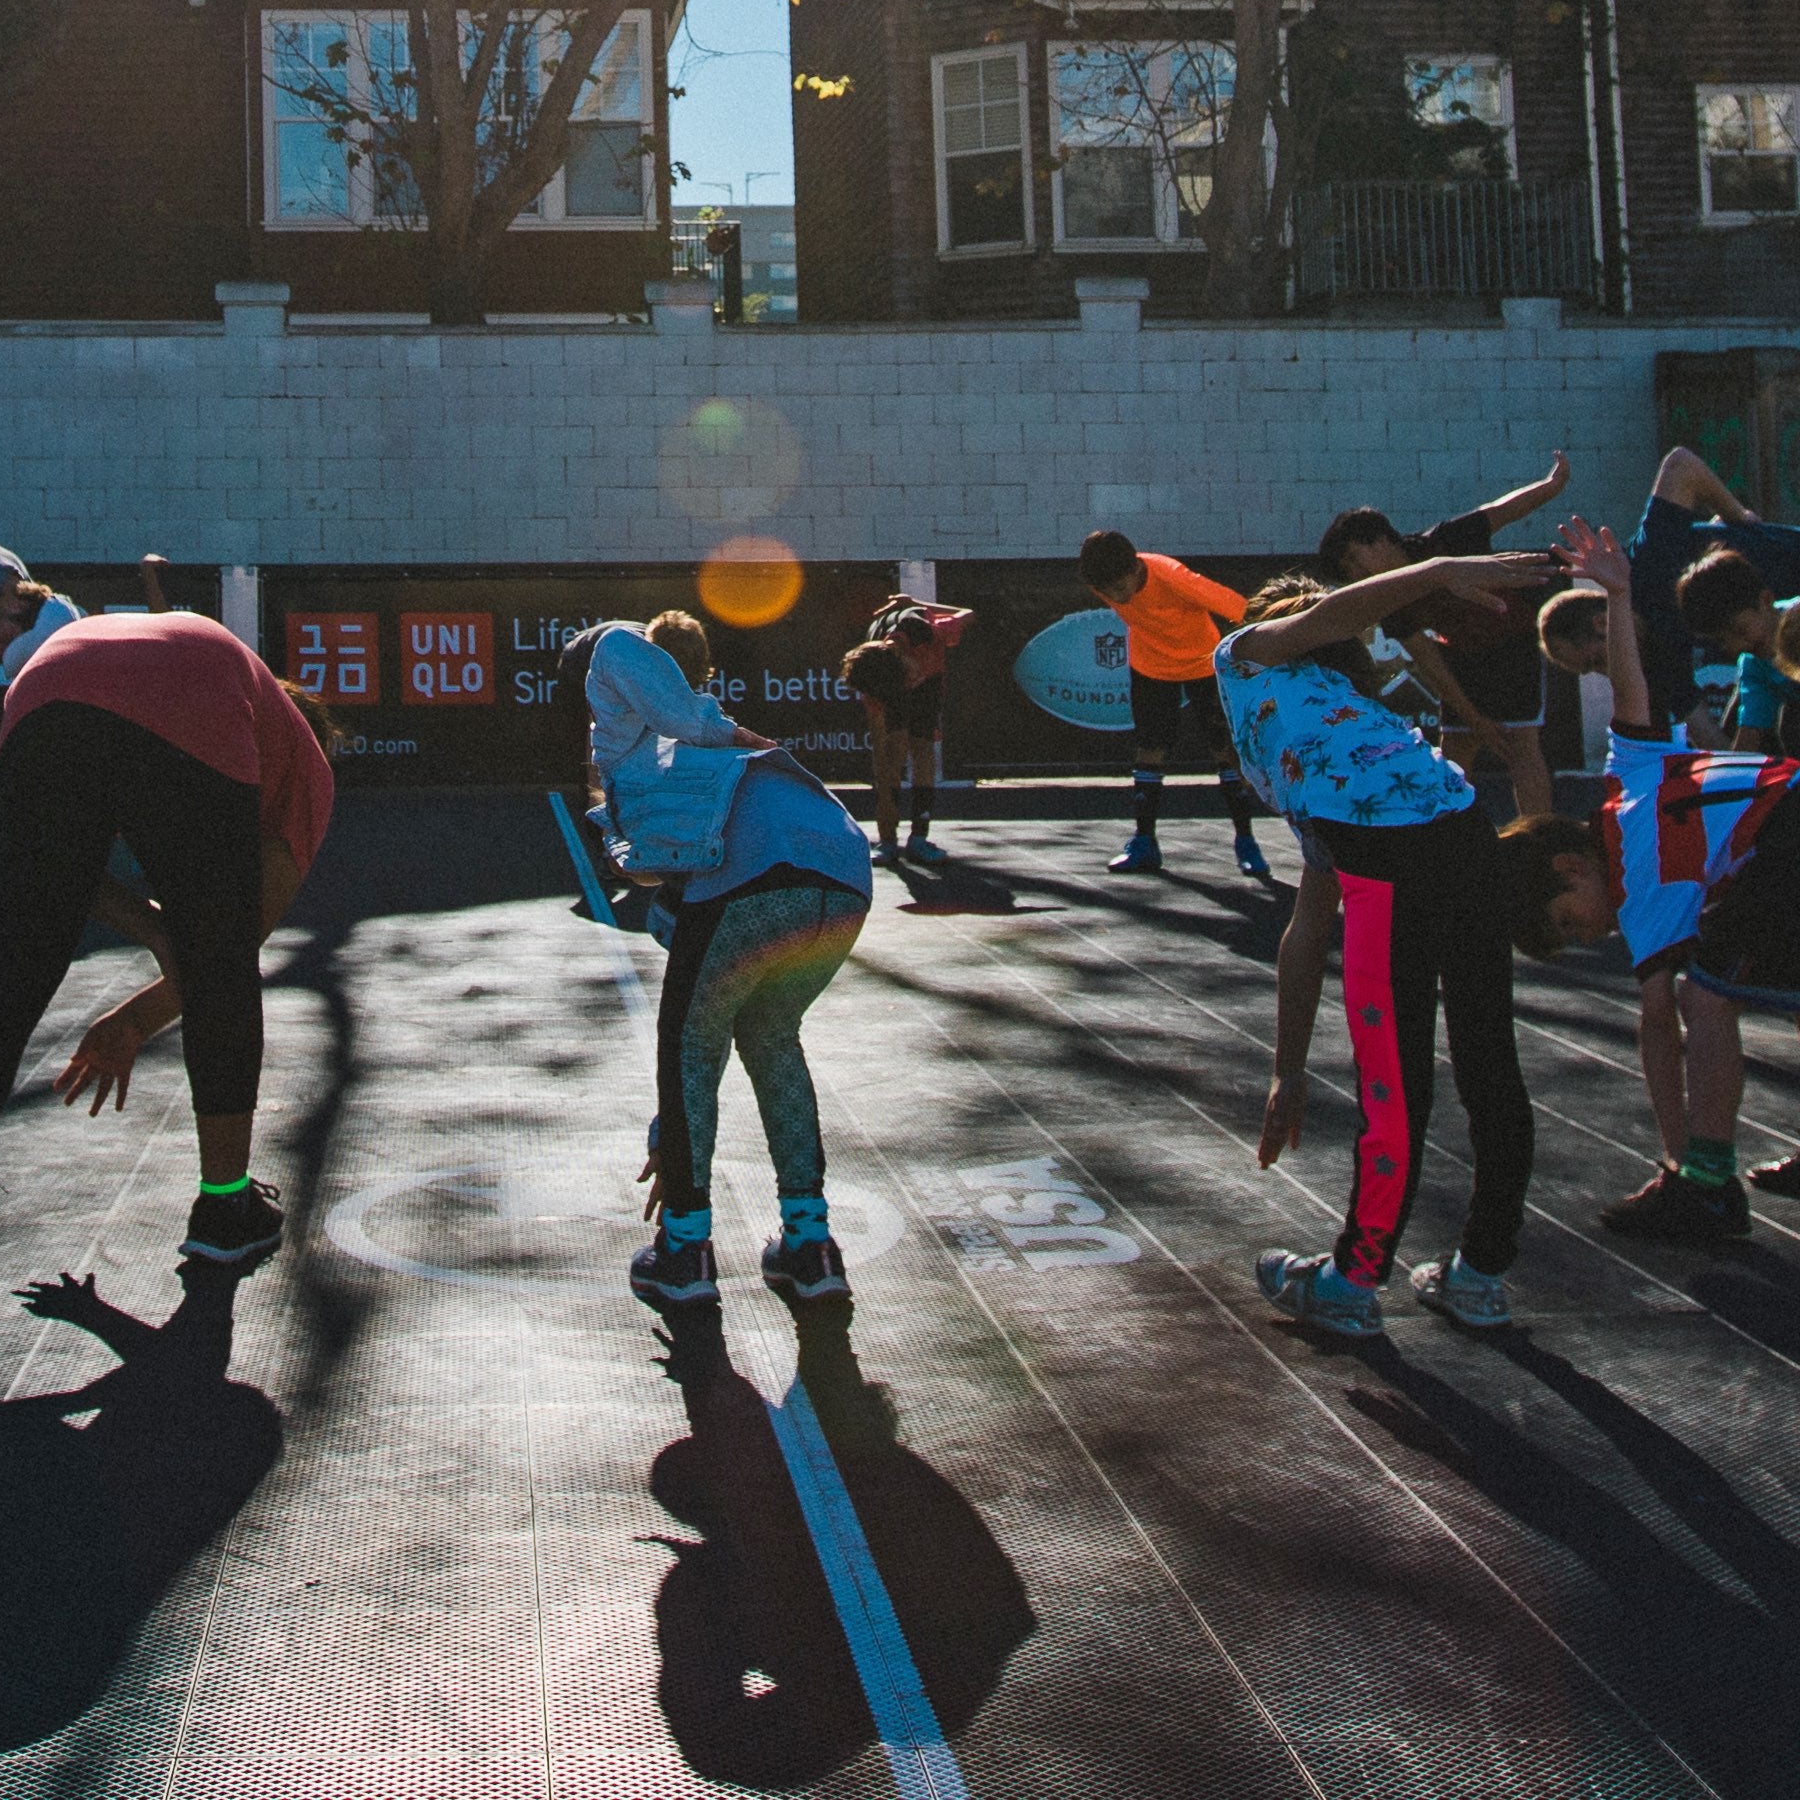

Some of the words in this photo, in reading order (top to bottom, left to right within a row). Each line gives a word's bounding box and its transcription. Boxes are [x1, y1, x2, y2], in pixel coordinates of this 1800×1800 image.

[411, 624, 477, 656] UNI
[1097, 646, 1126, 664] NFL
[412, 662, 484, 699] QLO
[763, 669, 862, 702] bette
[956, 1155, 1142, 1273] USA
